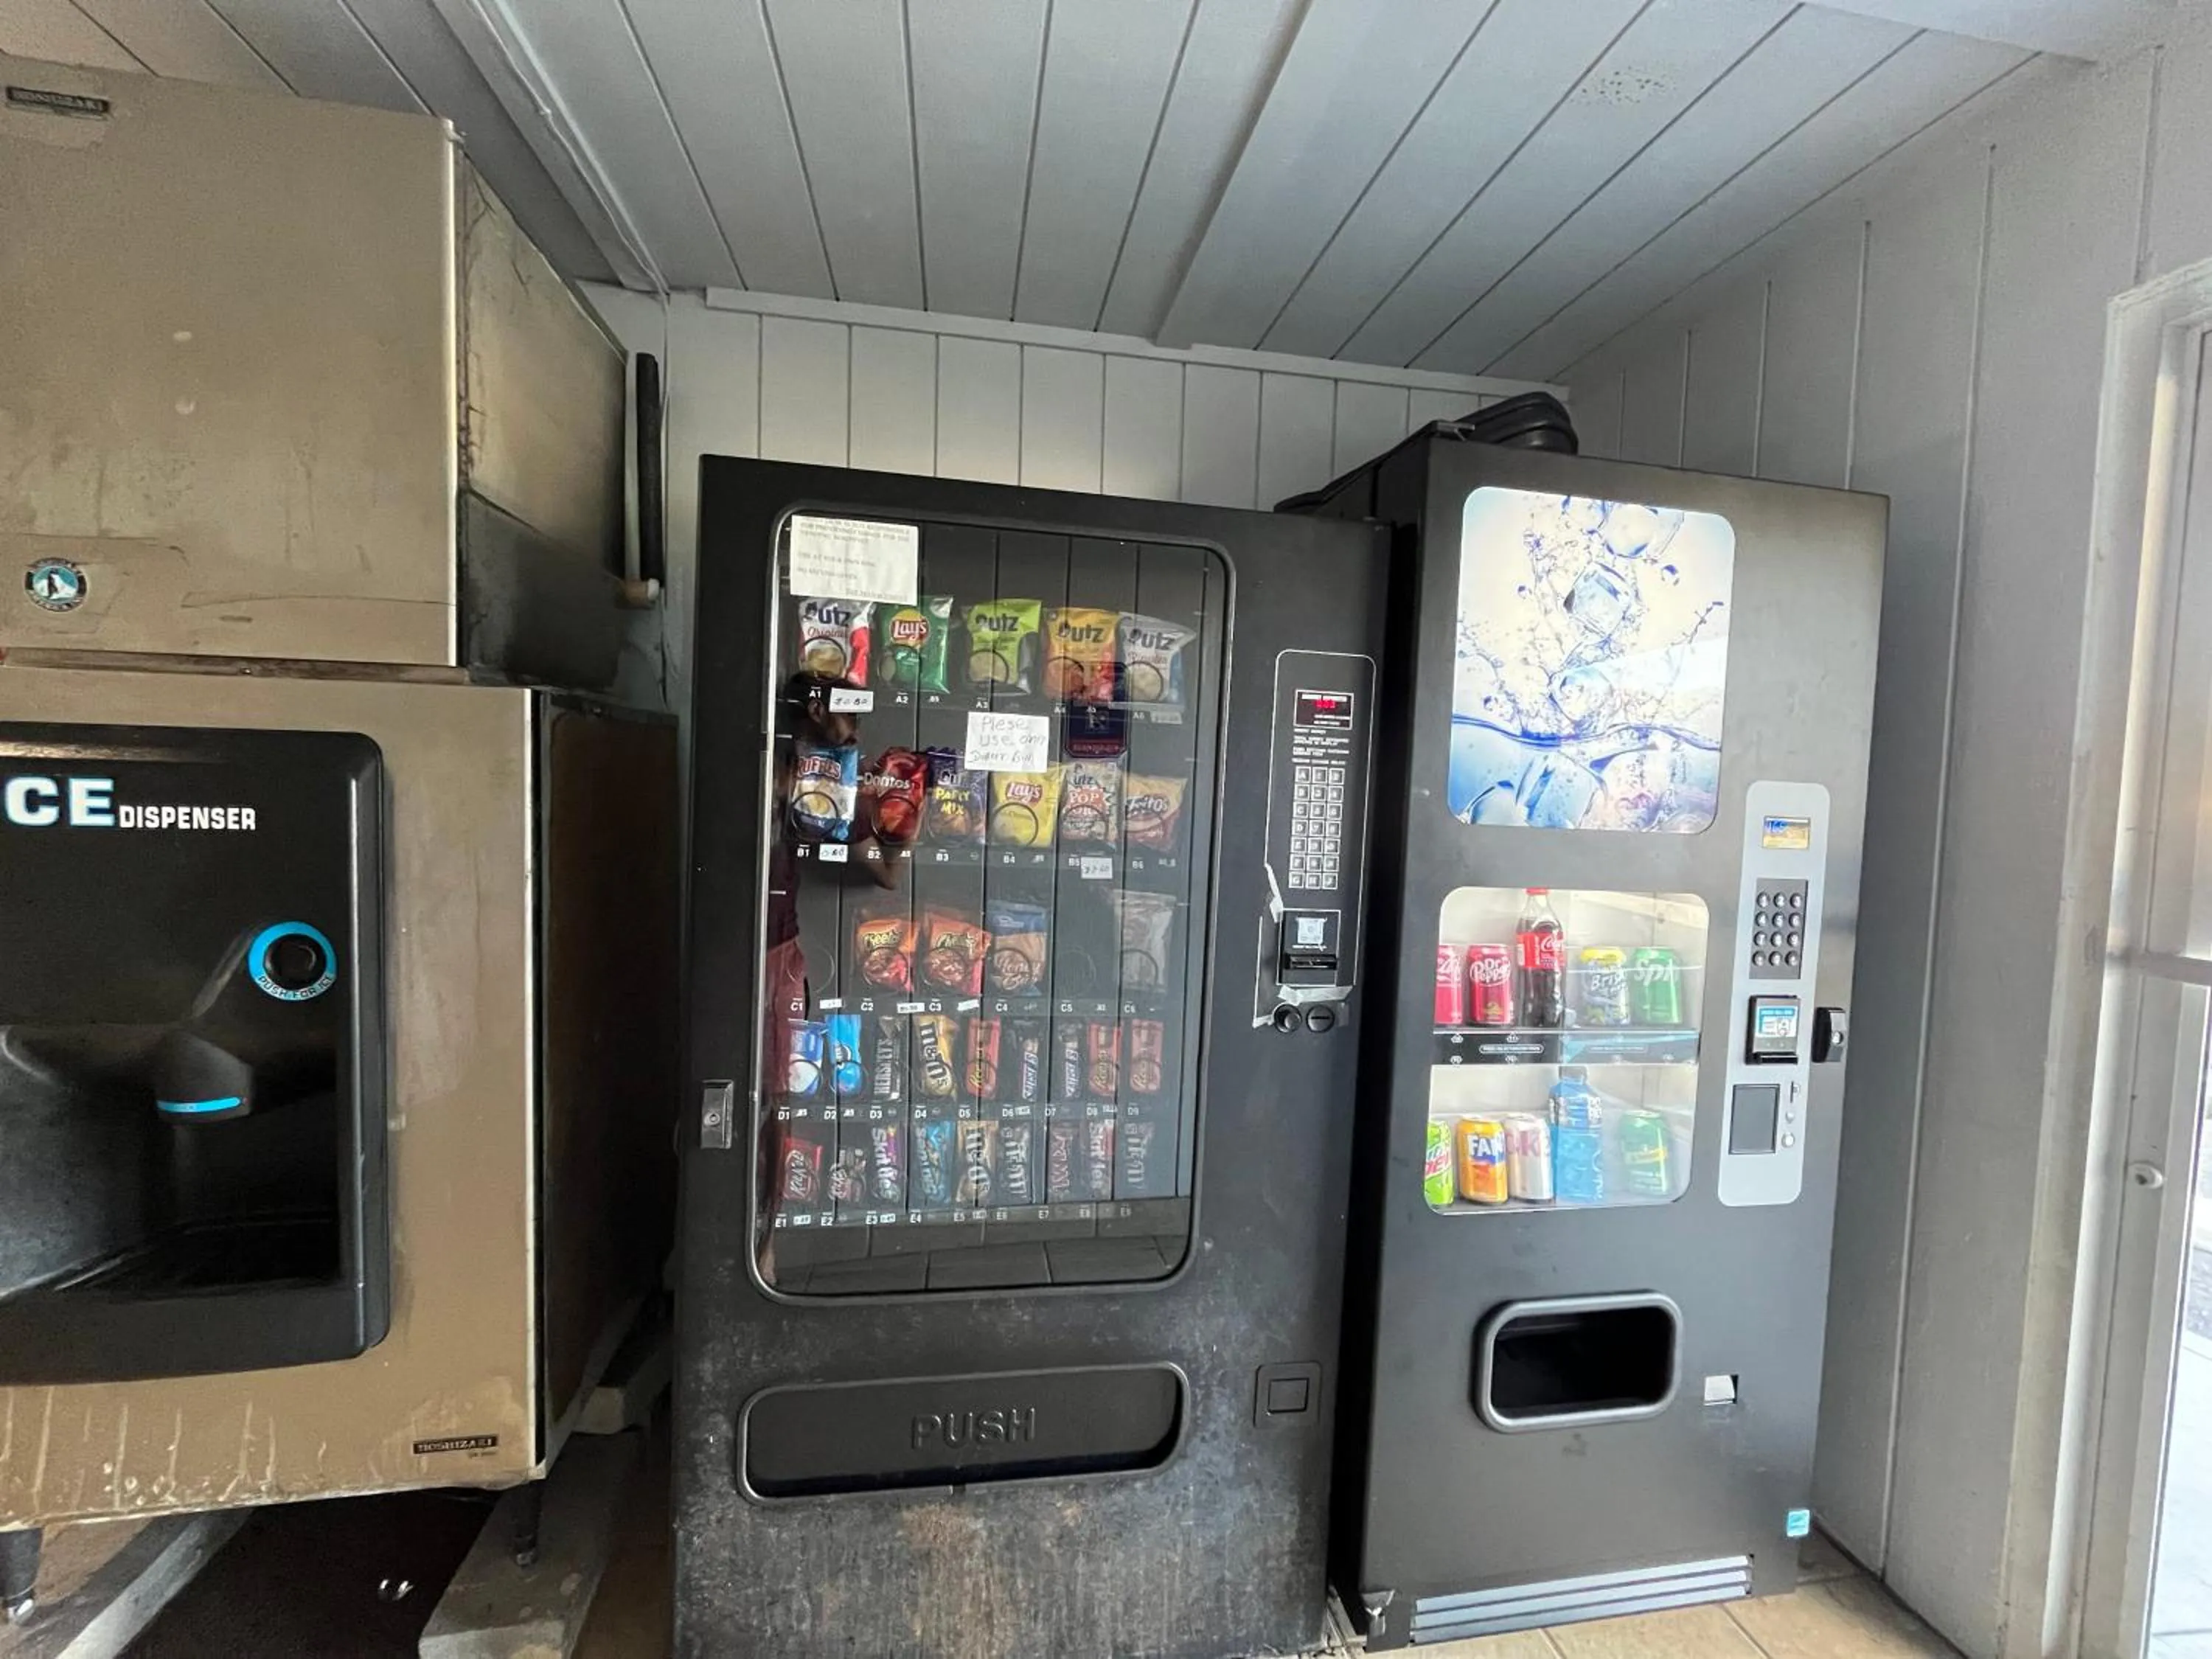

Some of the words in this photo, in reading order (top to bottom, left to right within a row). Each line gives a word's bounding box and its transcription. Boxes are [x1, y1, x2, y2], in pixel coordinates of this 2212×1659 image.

[893, 619, 927, 640] Lay's
[809, 689, 821, 698] A1
[896, 695, 908, 704] A2
[864, 772, 911, 789] Doritos
[941, 801, 964, 815] MIX
[119, 804, 257, 830] DISPENSER
[868, 850, 881, 859] B2
[1003, 855, 1015, 864] B4
[259, 975, 288, 998] PUSH
[293, 988, 317, 998] FOR
[860, 1002, 874, 1011] C2
[929, 1003, 942, 1011] C3
[995, 1003, 1008, 1012] C4
[778, 1111, 790, 1120] D1
[824, 1110, 837, 1119] D2
[870, 1110, 883, 1119] D3
[915, 1110, 927, 1119] D4
[959, 1109, 971, 1118] D5
[775, 1218, 787, 1227] E1
[821, 1218, 833, 1226] E2
[866, 1215, 877, 1224] E3
[911, 1214, 922, 1223] E4
[911, 1408, 1036, 1450] PUSH
